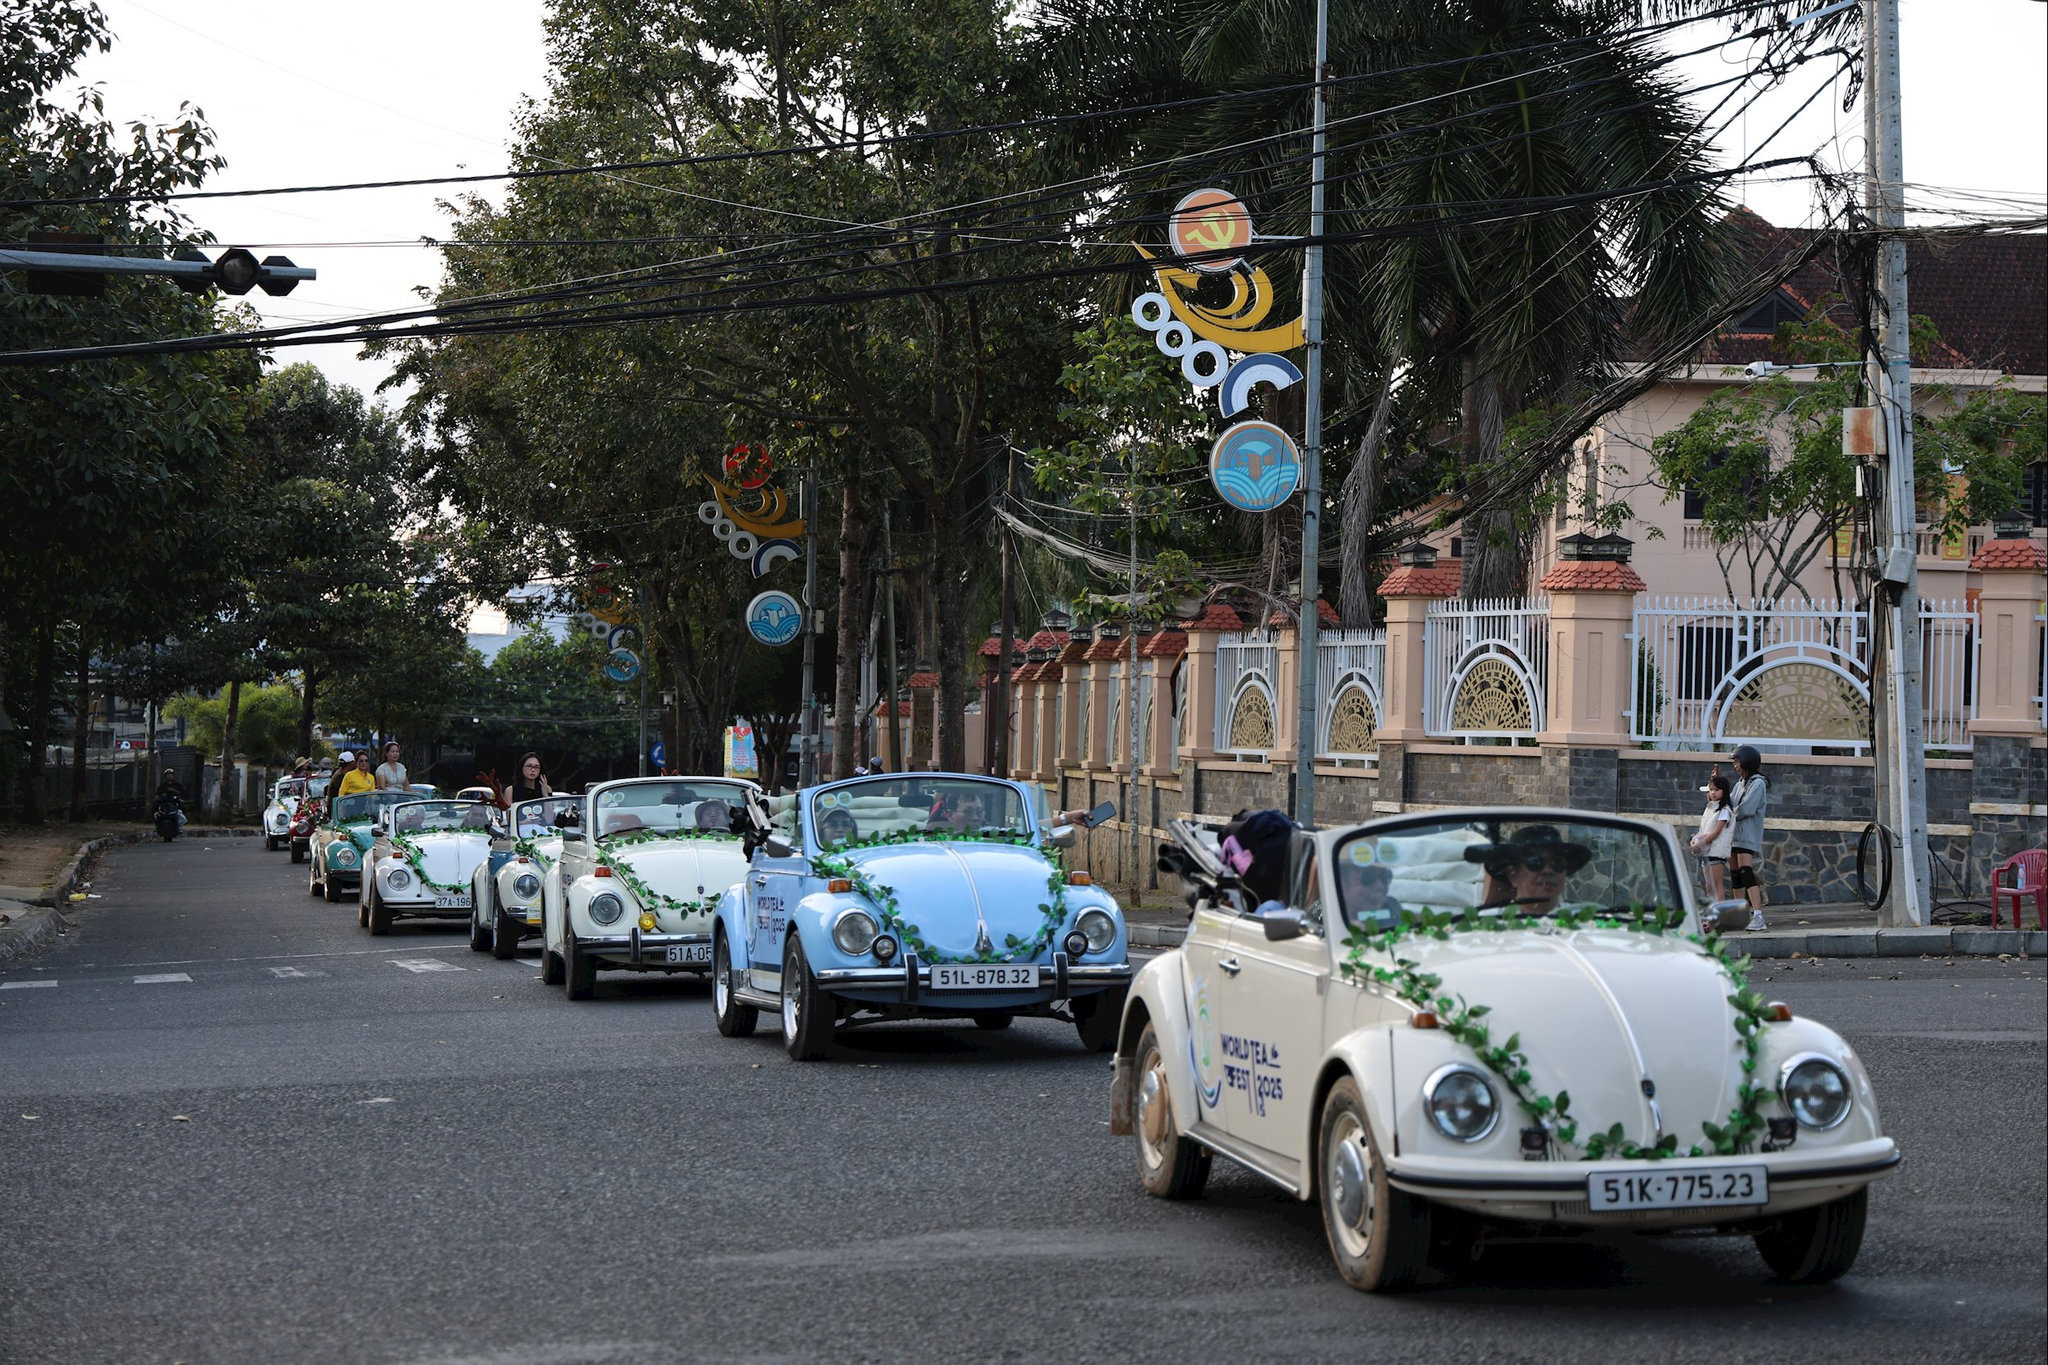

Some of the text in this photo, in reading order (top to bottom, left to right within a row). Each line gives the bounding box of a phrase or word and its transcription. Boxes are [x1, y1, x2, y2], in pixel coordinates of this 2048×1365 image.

[669, 946, 712, 962] 51A-05
[940, 969, 1030, 985] 51L-878.32
[1220, 1033, 1249, 1060] WORLD
[1257, 1074, 1283, 1101] 2025
[1604, 1173, 1754, 1203] 51K-775.23
